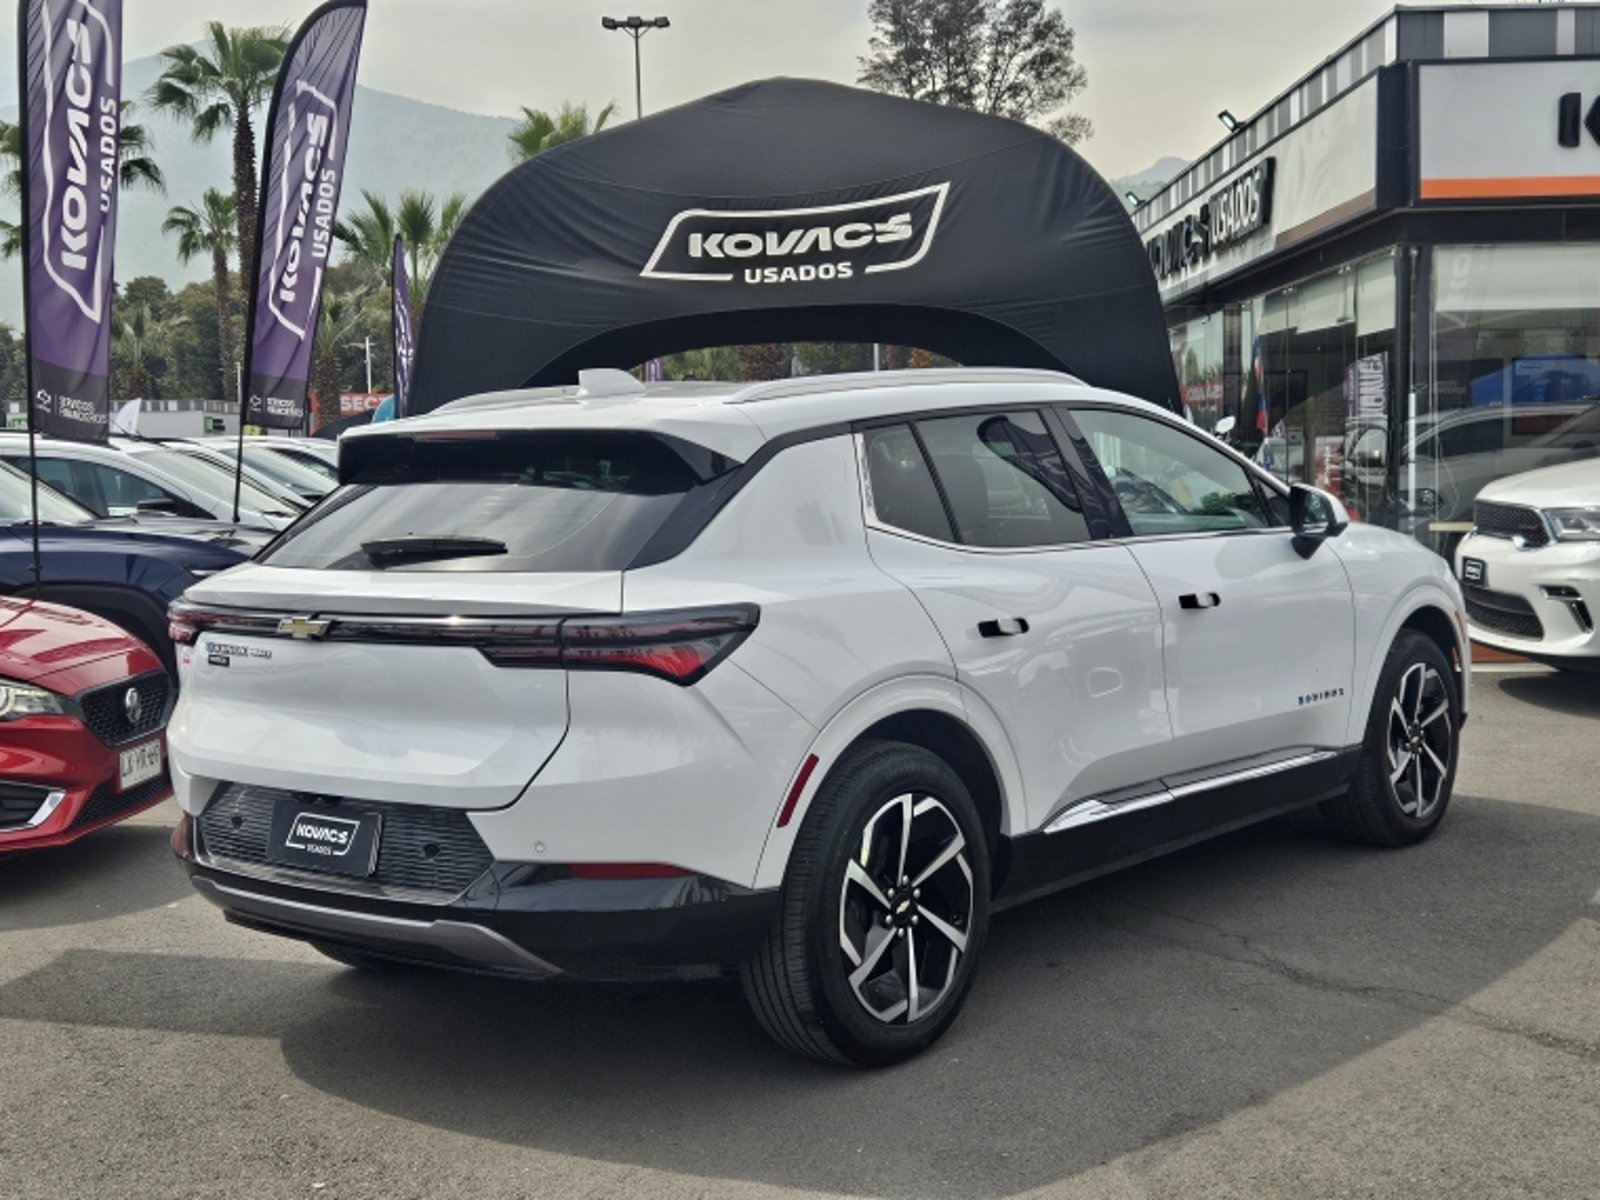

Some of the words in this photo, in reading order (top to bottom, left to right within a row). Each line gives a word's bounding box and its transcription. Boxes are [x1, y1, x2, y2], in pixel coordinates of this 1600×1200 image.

[61, 18, 92, 271] KOVACS
[100, 96, 117, 214] USADOS
[279, 112, 329, 302] KOVACS
[312, 168, 336, 258] USADOS
[688, 213, 912, 258] KOVACS
[744, 262, 853, 284] USADOS
[340, 395, 386, 411] SEC
[296, 823, 348, 844] KOVACS
